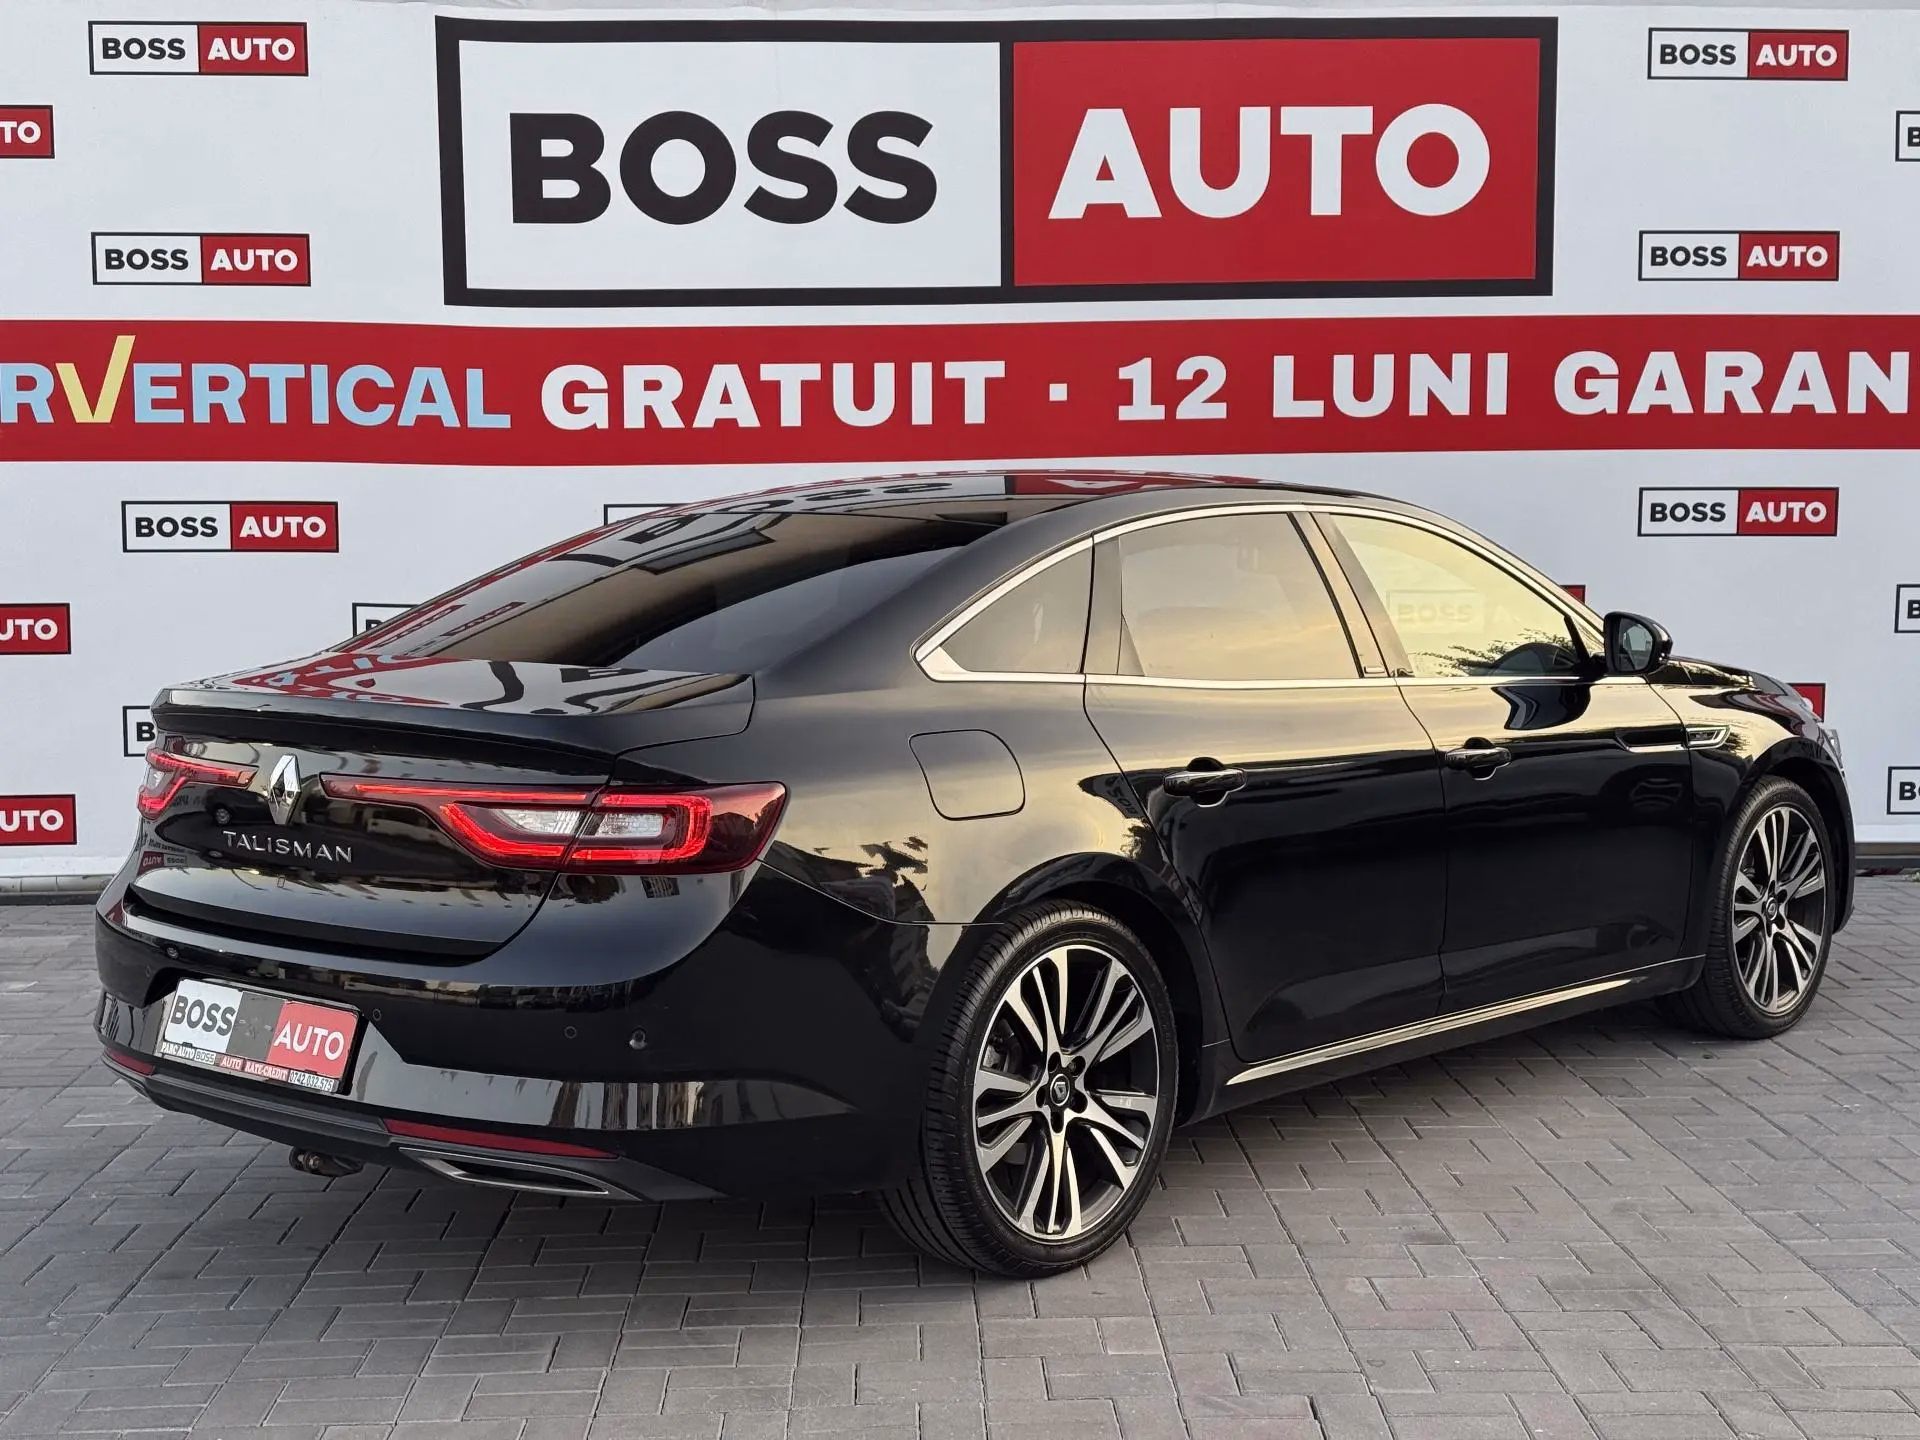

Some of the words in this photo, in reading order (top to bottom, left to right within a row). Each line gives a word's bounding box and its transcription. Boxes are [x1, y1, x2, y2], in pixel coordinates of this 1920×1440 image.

[102, 38, 185, 60] BOSS
[208, 38, 295, 61] AUTO
[1660, 44, 1736, 65] BOSS
[1756, 44, 1837, 66] AUTO
[0, 121, 41, 143] TO
[510, 110, 936, 225] BOSS
[1048, 104, 1490, 219] AUTO
[105, 249, 188, 270] BOSS
[211, 249, 298, 271] AUTO
[1651, 246, 1726, 266] BOSS
[1747, 246, 1828, 267] AUTO
[541, 361, 1005, 430] GRATUIT
[1118, 356, 1227, 421] 12
[1273, 353, 1508, 418] LUNI
[1554, 350, 1910, 415] GARAN
[1650, 503, 1726, 522] BOSS
[1746, 502, 1826, 523] AUTO
[135, 516, 218, 537] BOSS
[240, 516, 326, 538] AUTO
[1899, 782, 1920, 800] B
[0, 809, 64, 832] UTO
[222, 830, 353, 863] TALISMAN
[170, 996, 236, 1036] BOSS
[273, 1020, 345, 1061] AUTO
[177, 1046, 196, 1059] AUTO
[196, 1050, 215, 1064] BOSS
[221, 1056, 242, 1070] AUTO
